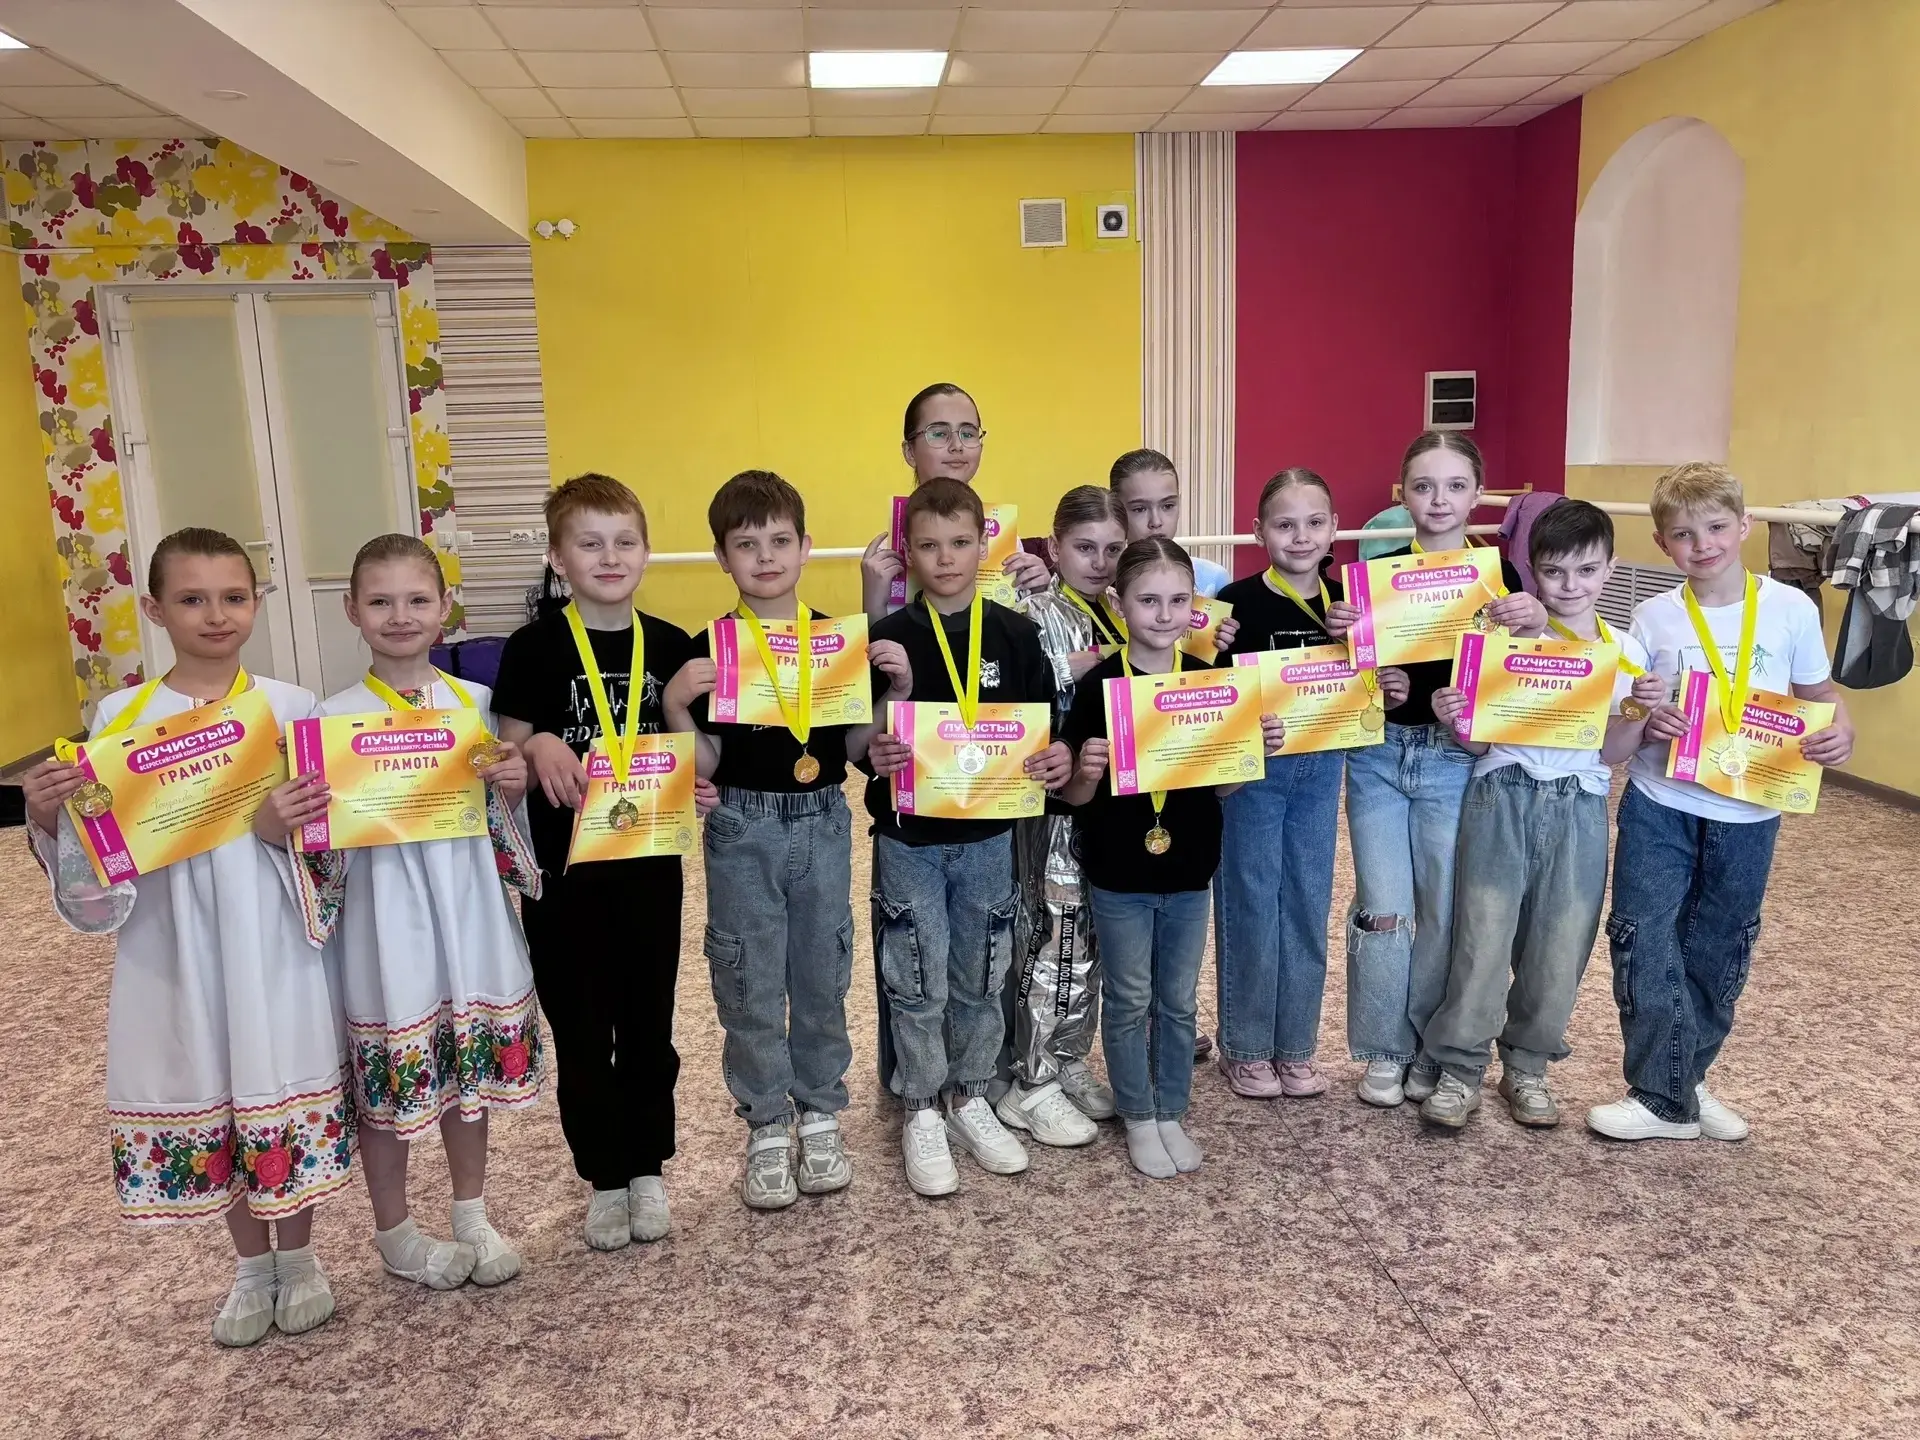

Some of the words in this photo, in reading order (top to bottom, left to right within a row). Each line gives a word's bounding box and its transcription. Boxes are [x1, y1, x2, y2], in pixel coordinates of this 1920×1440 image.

[1398, 565, 1472, 584] ЛУЧИСТЫЙ
[1409, 588, 1464, 604] ГРАМОТА
[768, 634, 838, 647] ЛУЧИТЫЙ
[777, 656, 829, 669] ГРАОТА
[1511, 656, 1586, 670] ЛУЧИСТЫЙ
[1297, 682, 1347, 697] ГРАМОТА
[1517, 677, 1573, 691] ГРАМОТА
[1161, 686, 1232, 704] ЛУЧИСТЫЙ
[1171, 710, 1224, 727] ГРАМОТА
[1746, 707, 1799, 728] ЧИСТЫЙ
[944, 721, 1018, 733] ЛУИСТЫЙ
[136, 721, 236, 765] ЛУЧИСТЫЙ
[360, 729, 448, 746] ЛУЧИСТЫЙ
[1738, 727, 1783, 749] РАМОТА
[138, 751, 184, 772] ВСЕРОССИЙСКИЙ
[183, 734, 239, 758] КОНКУРС-ФЕСТИВАЛЬ
[953, 745, 1008, 756] ГРМОТА
[374, 756, 439, 773] ГРАМОТА
[593, 752, 671, 769] ЛУСТЫЙ
[158, 752, 234, 787] ГРАМОТА
[603, 778, 662, 793] ГРАМОТА
